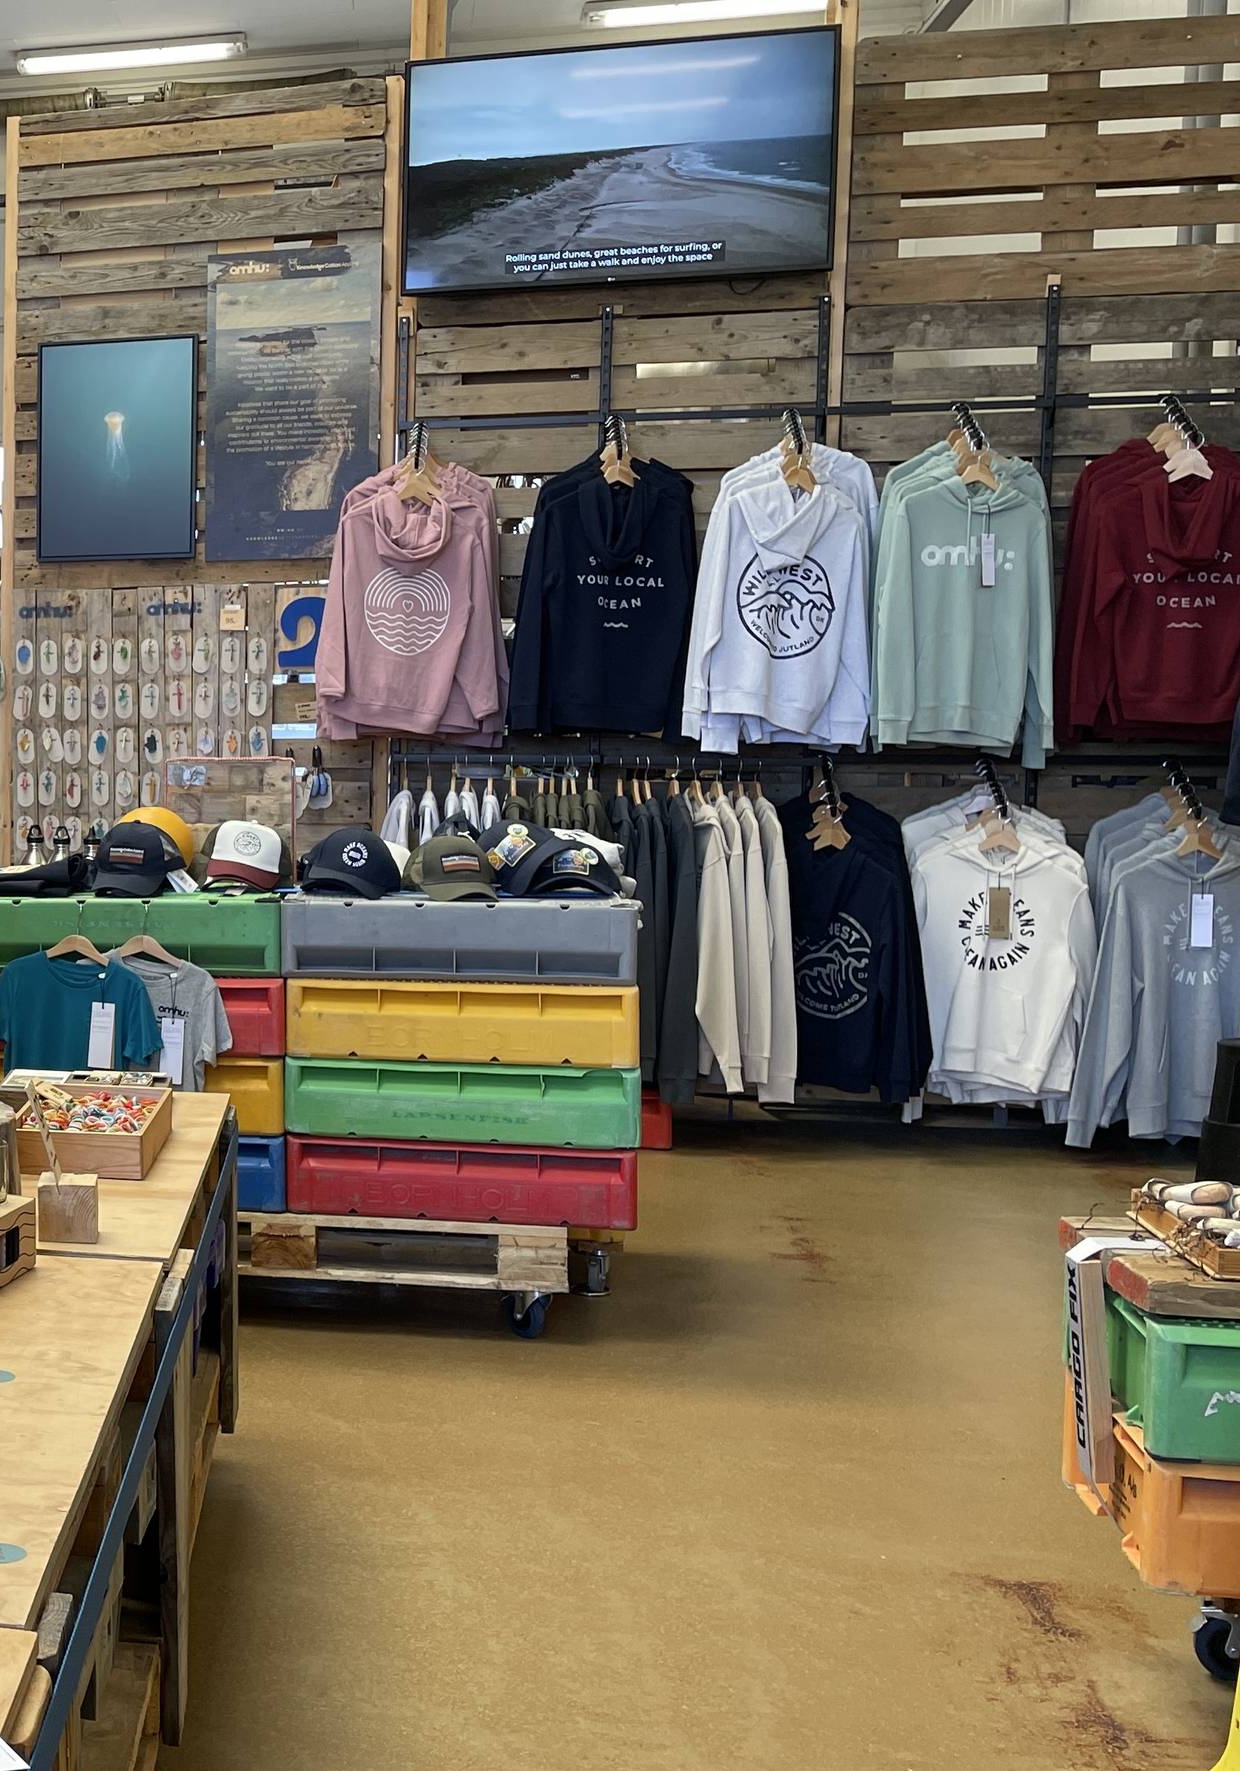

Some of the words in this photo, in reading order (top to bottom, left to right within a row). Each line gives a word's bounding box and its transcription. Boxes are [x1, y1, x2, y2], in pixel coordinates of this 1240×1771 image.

[506, 254, 537, 263] Rolling
[538, 252, 561, 261] sand
[562, 250, 593, 260] dunes,
[594, 248, 619, 259] great
[620, 246, 658, 256] beaches
[659, 244, 673, 253] for
[674, 242, 710, 253] surfing,
[711, 242, 723, 250] or
[513, 264, 531, 273] you
[549, 261, 568, 271] just
[569, 259, 589, 269] take
[598, 257, 620, 266] walk
[621, 256, 640, 265] and
[641, 255, 666, 266] enjoy
[668, 254, 684, 263] the
[685, 253, 713, 264] space
[577, 575, 609, 585] YOUR
[615, 576, 664, 587] LOCAL
[598, 596, 642, 609] OCEAN
[1156, 595, 1216, 609] OCEAN
[1066, 1265, 1080, 1322] FIX
[1070, 1328, 1086, 1450] CARGO
